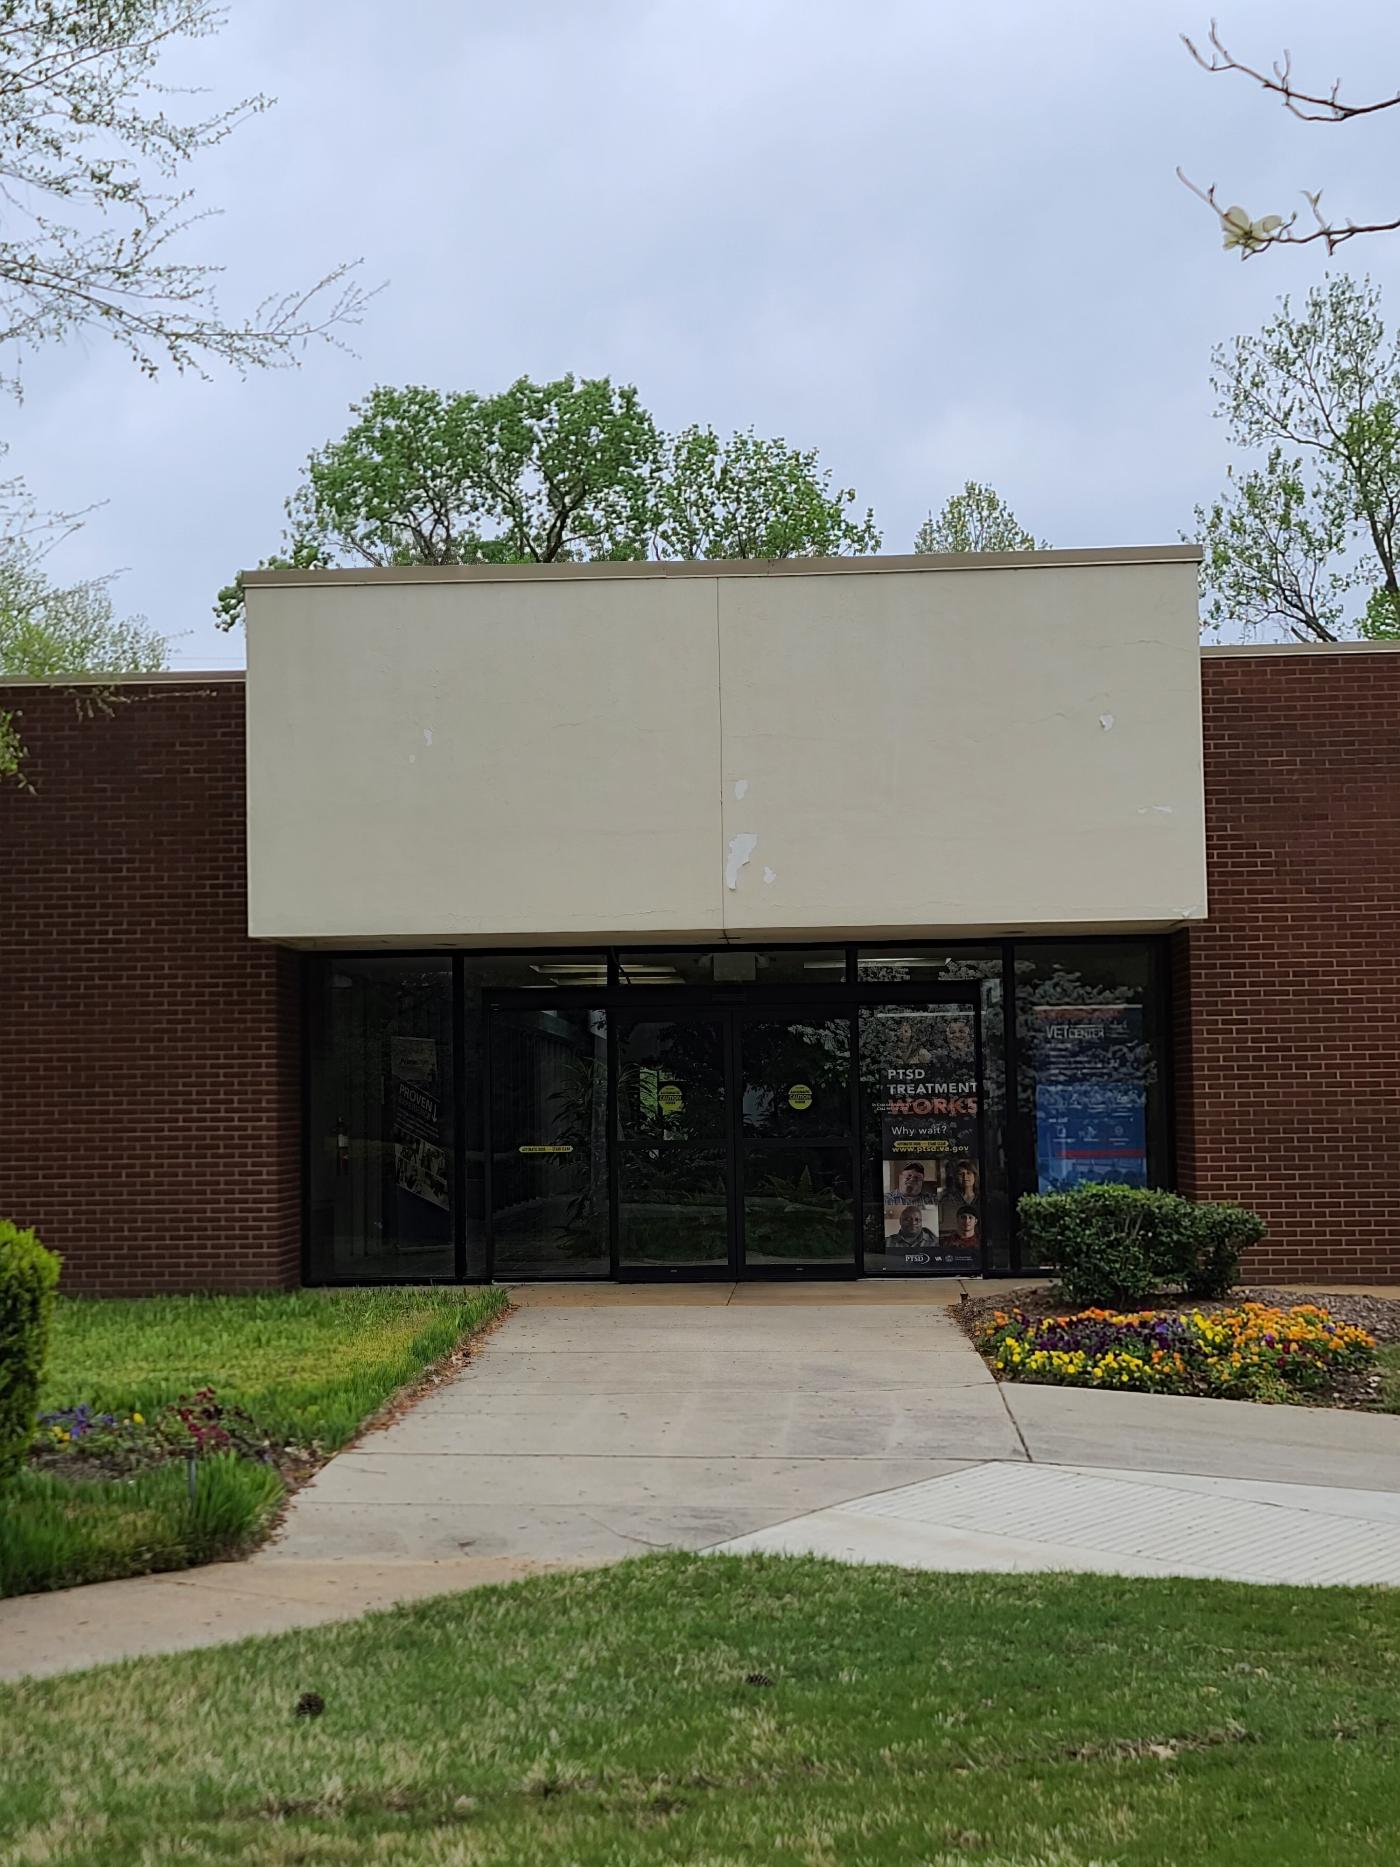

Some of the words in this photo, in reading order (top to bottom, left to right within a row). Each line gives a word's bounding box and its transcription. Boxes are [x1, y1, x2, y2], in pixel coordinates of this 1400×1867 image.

[1046, 1024, 1069, 1039] VET
[887, 1068, 926, 1080] PTSD
[886, 1082, 978, 1095] TREATMENT
[399, 1081, 433, 1112] PROVEN
[887, 1097, 978, 1115] WORKS
[891, 1125, 915, 1136] Why
[918, 1125, 947, 1135] wait?
[892, 1145, 969, 1154] www.ptsd.va.gov
[905, 1254, 924, 1262] PTSD
